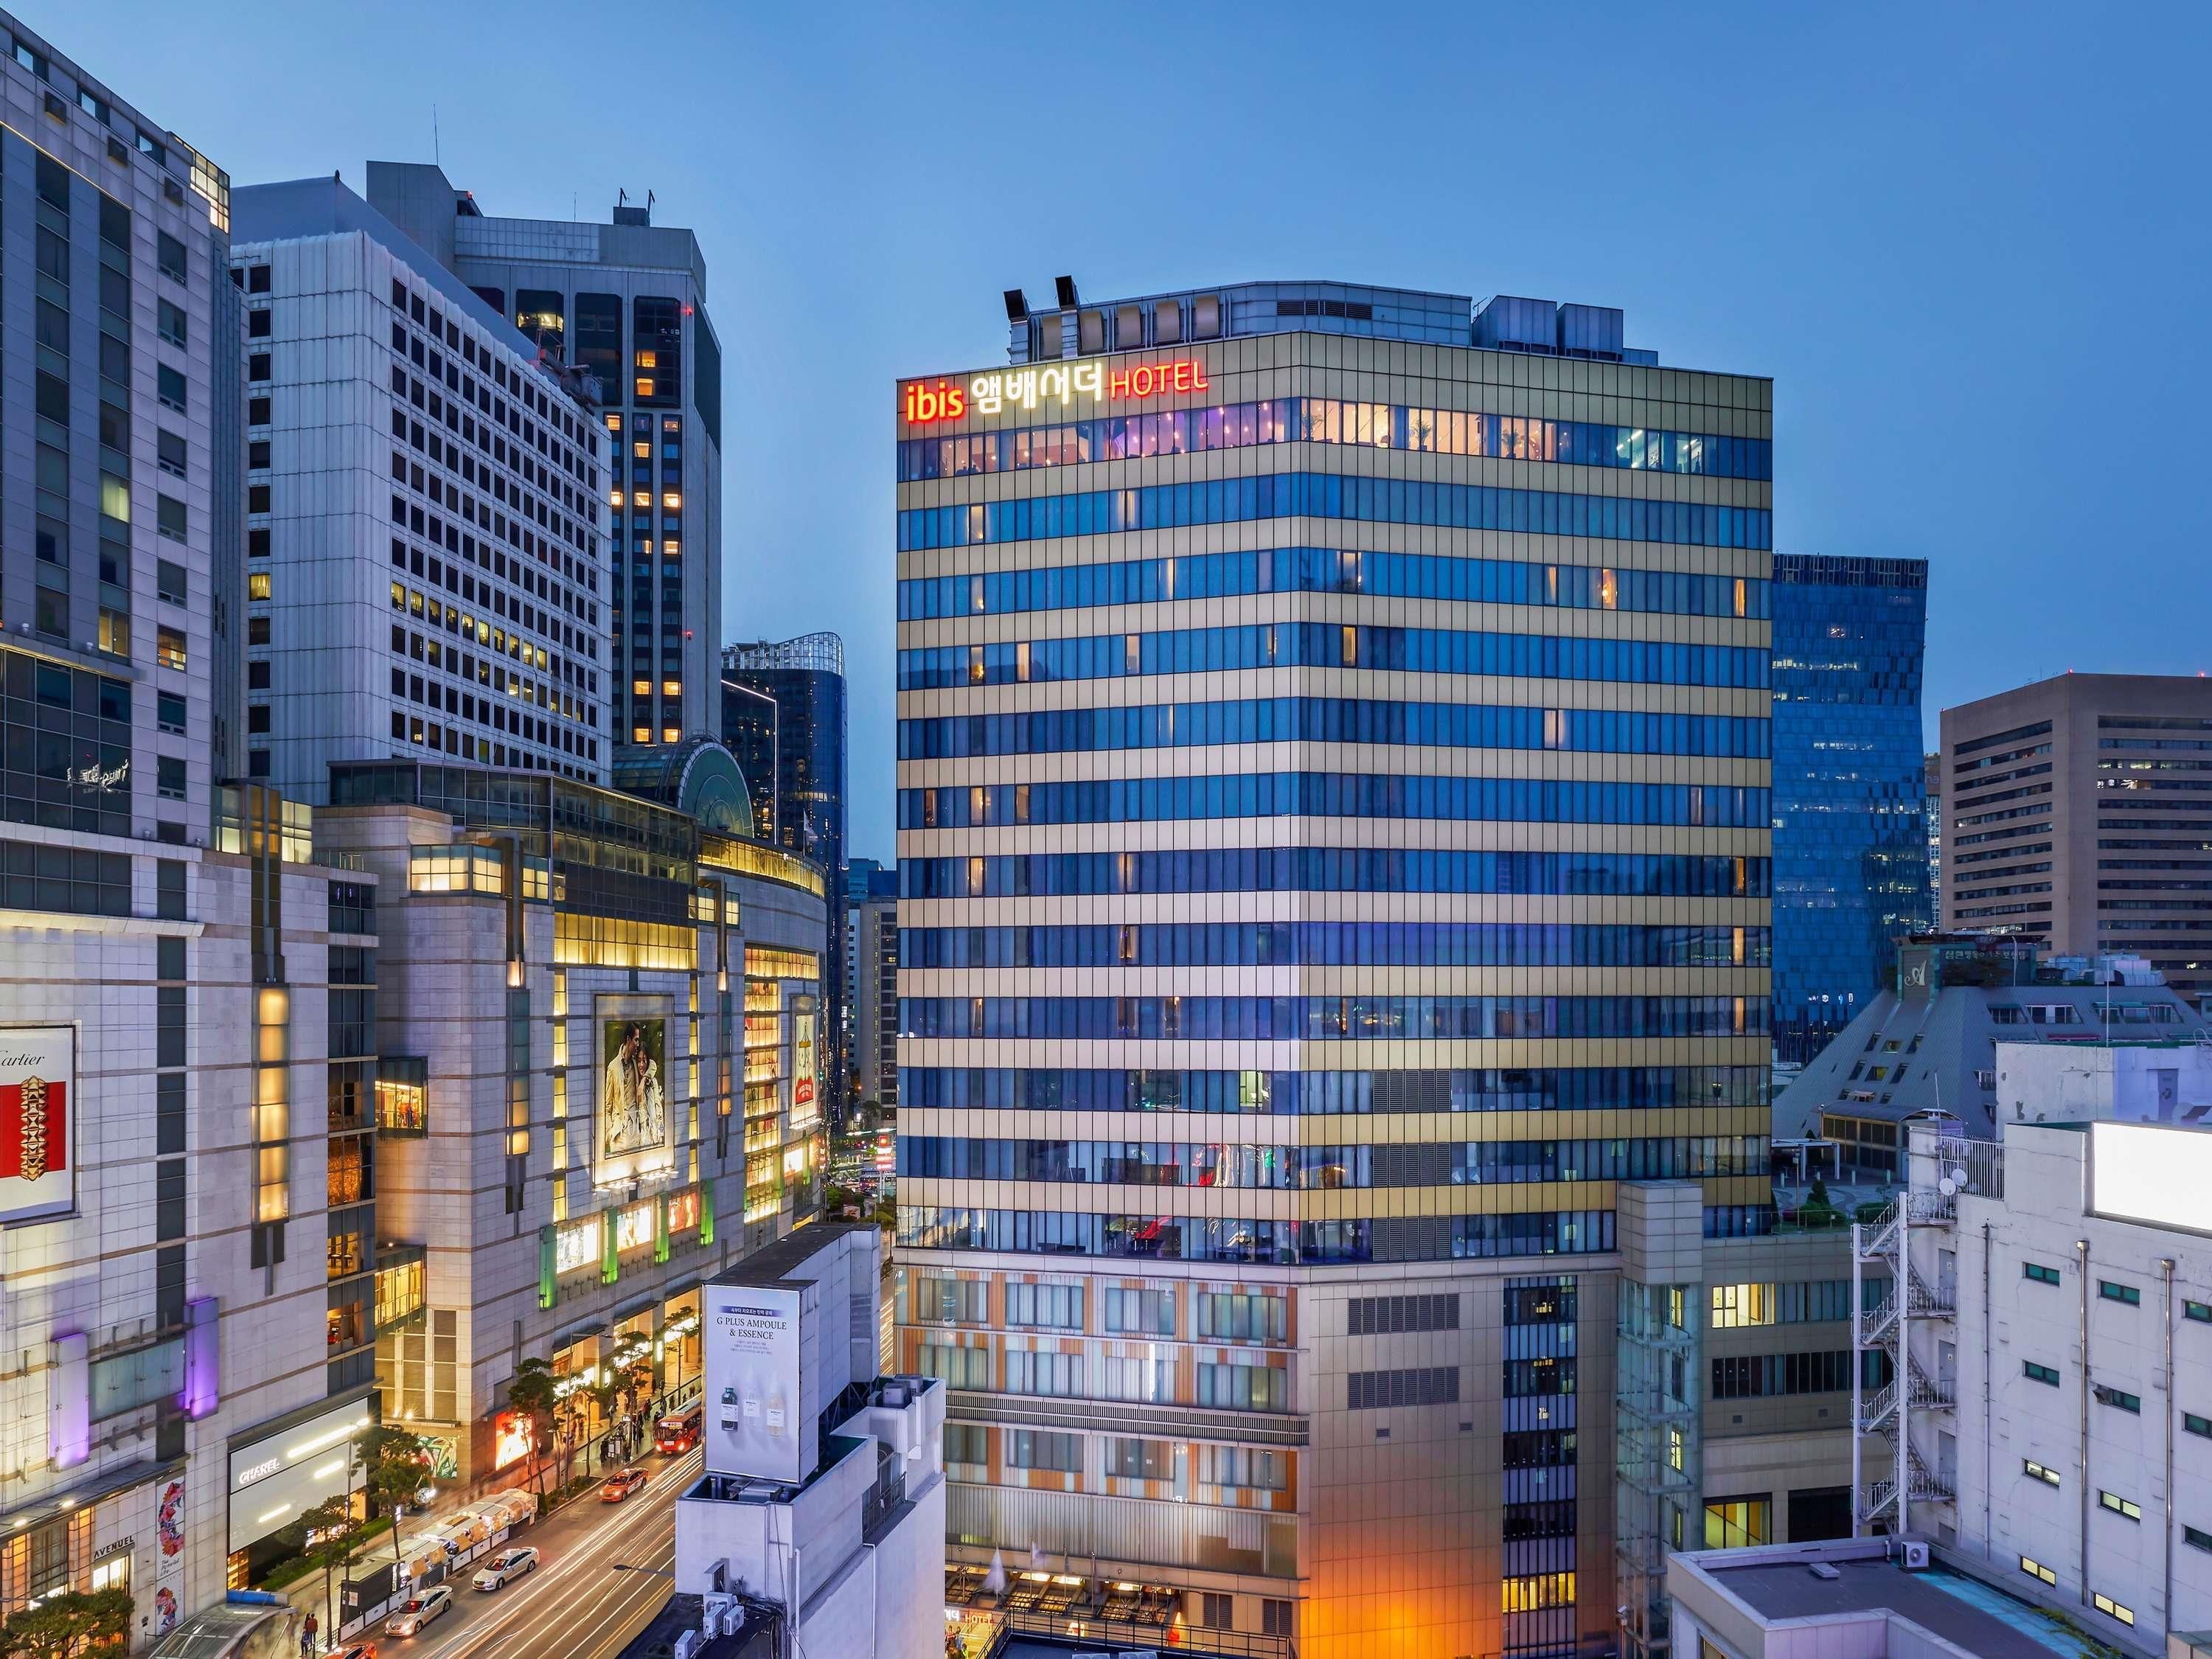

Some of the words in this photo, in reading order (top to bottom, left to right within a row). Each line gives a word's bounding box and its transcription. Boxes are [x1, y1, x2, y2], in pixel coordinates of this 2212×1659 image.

[907, 381, 964, 422] ibis
[971, 362, 1102, 414] 앰배서더
[1110, 361, 1208, 399] HOTEL
[0, 1050, 45, 1066] artier
[717, 1317, 723, 1325] G
[726, 1318, 745, 1326] PLUS
[747, 1319, 787, 1330] AMPOULE
[729, 1329, 736, 1337] &
[738, 1329, 773, 1340] ESSENCE
[94, 1535, 134, 1559] AVENUEL
[964, 1613, 992, 1624] HOTEL
